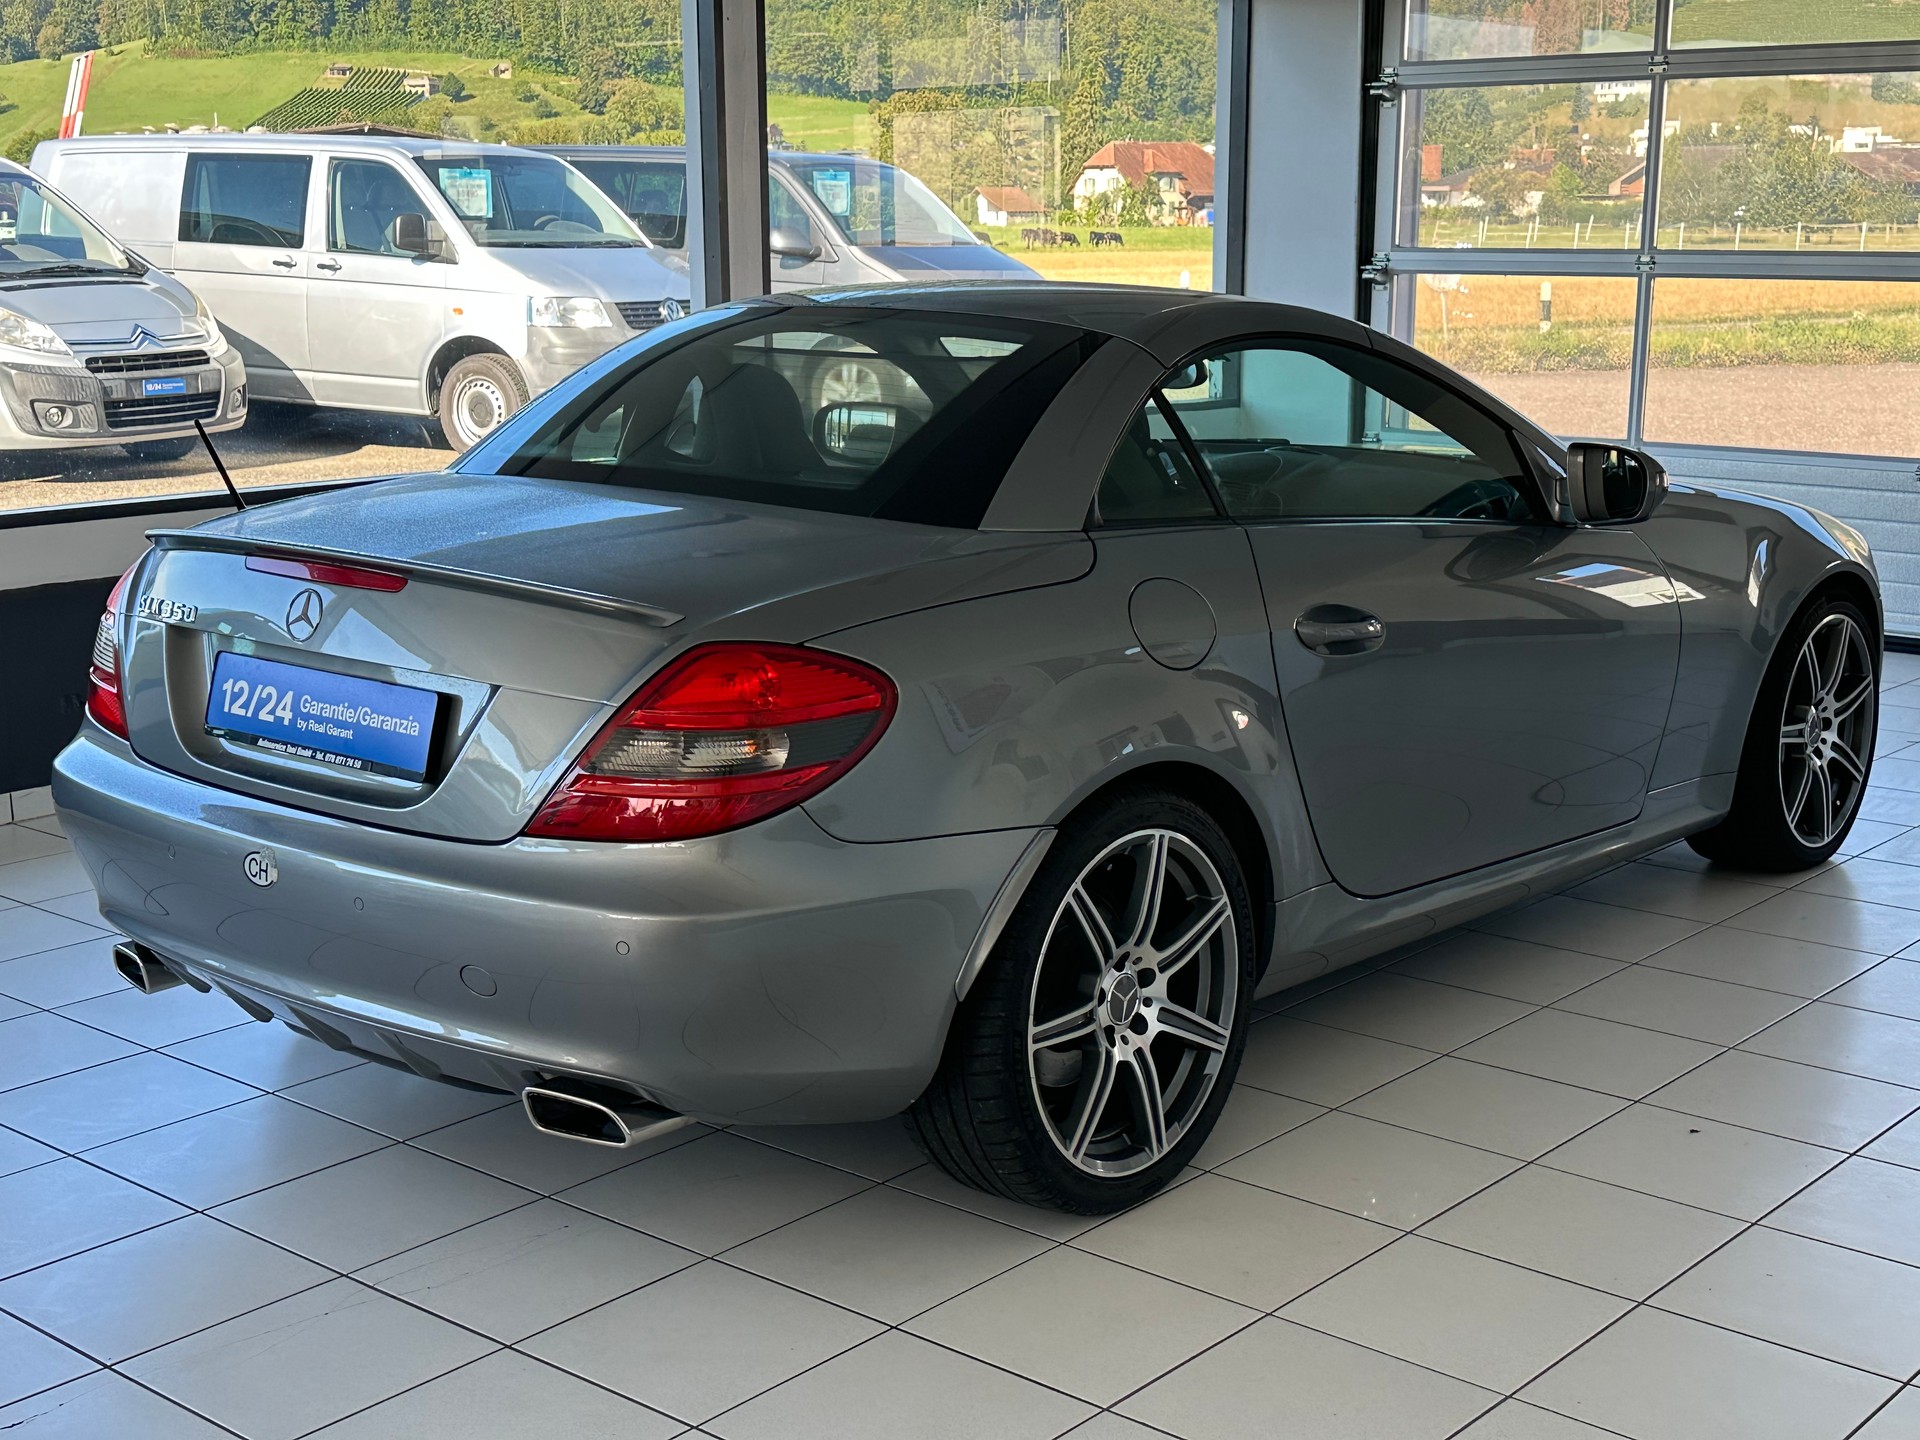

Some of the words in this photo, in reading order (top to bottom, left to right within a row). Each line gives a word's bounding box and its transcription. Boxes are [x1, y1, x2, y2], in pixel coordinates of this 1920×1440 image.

[222, 678, 294, 726] 12/24
[300, 695, 420, 736] Garantie/Garanzia
[297, 717, 309, 731] by
[308, 719, 326, 734] Real
[326, 724, 354, 740] Garant
[249, 857, 269, 882] CH
